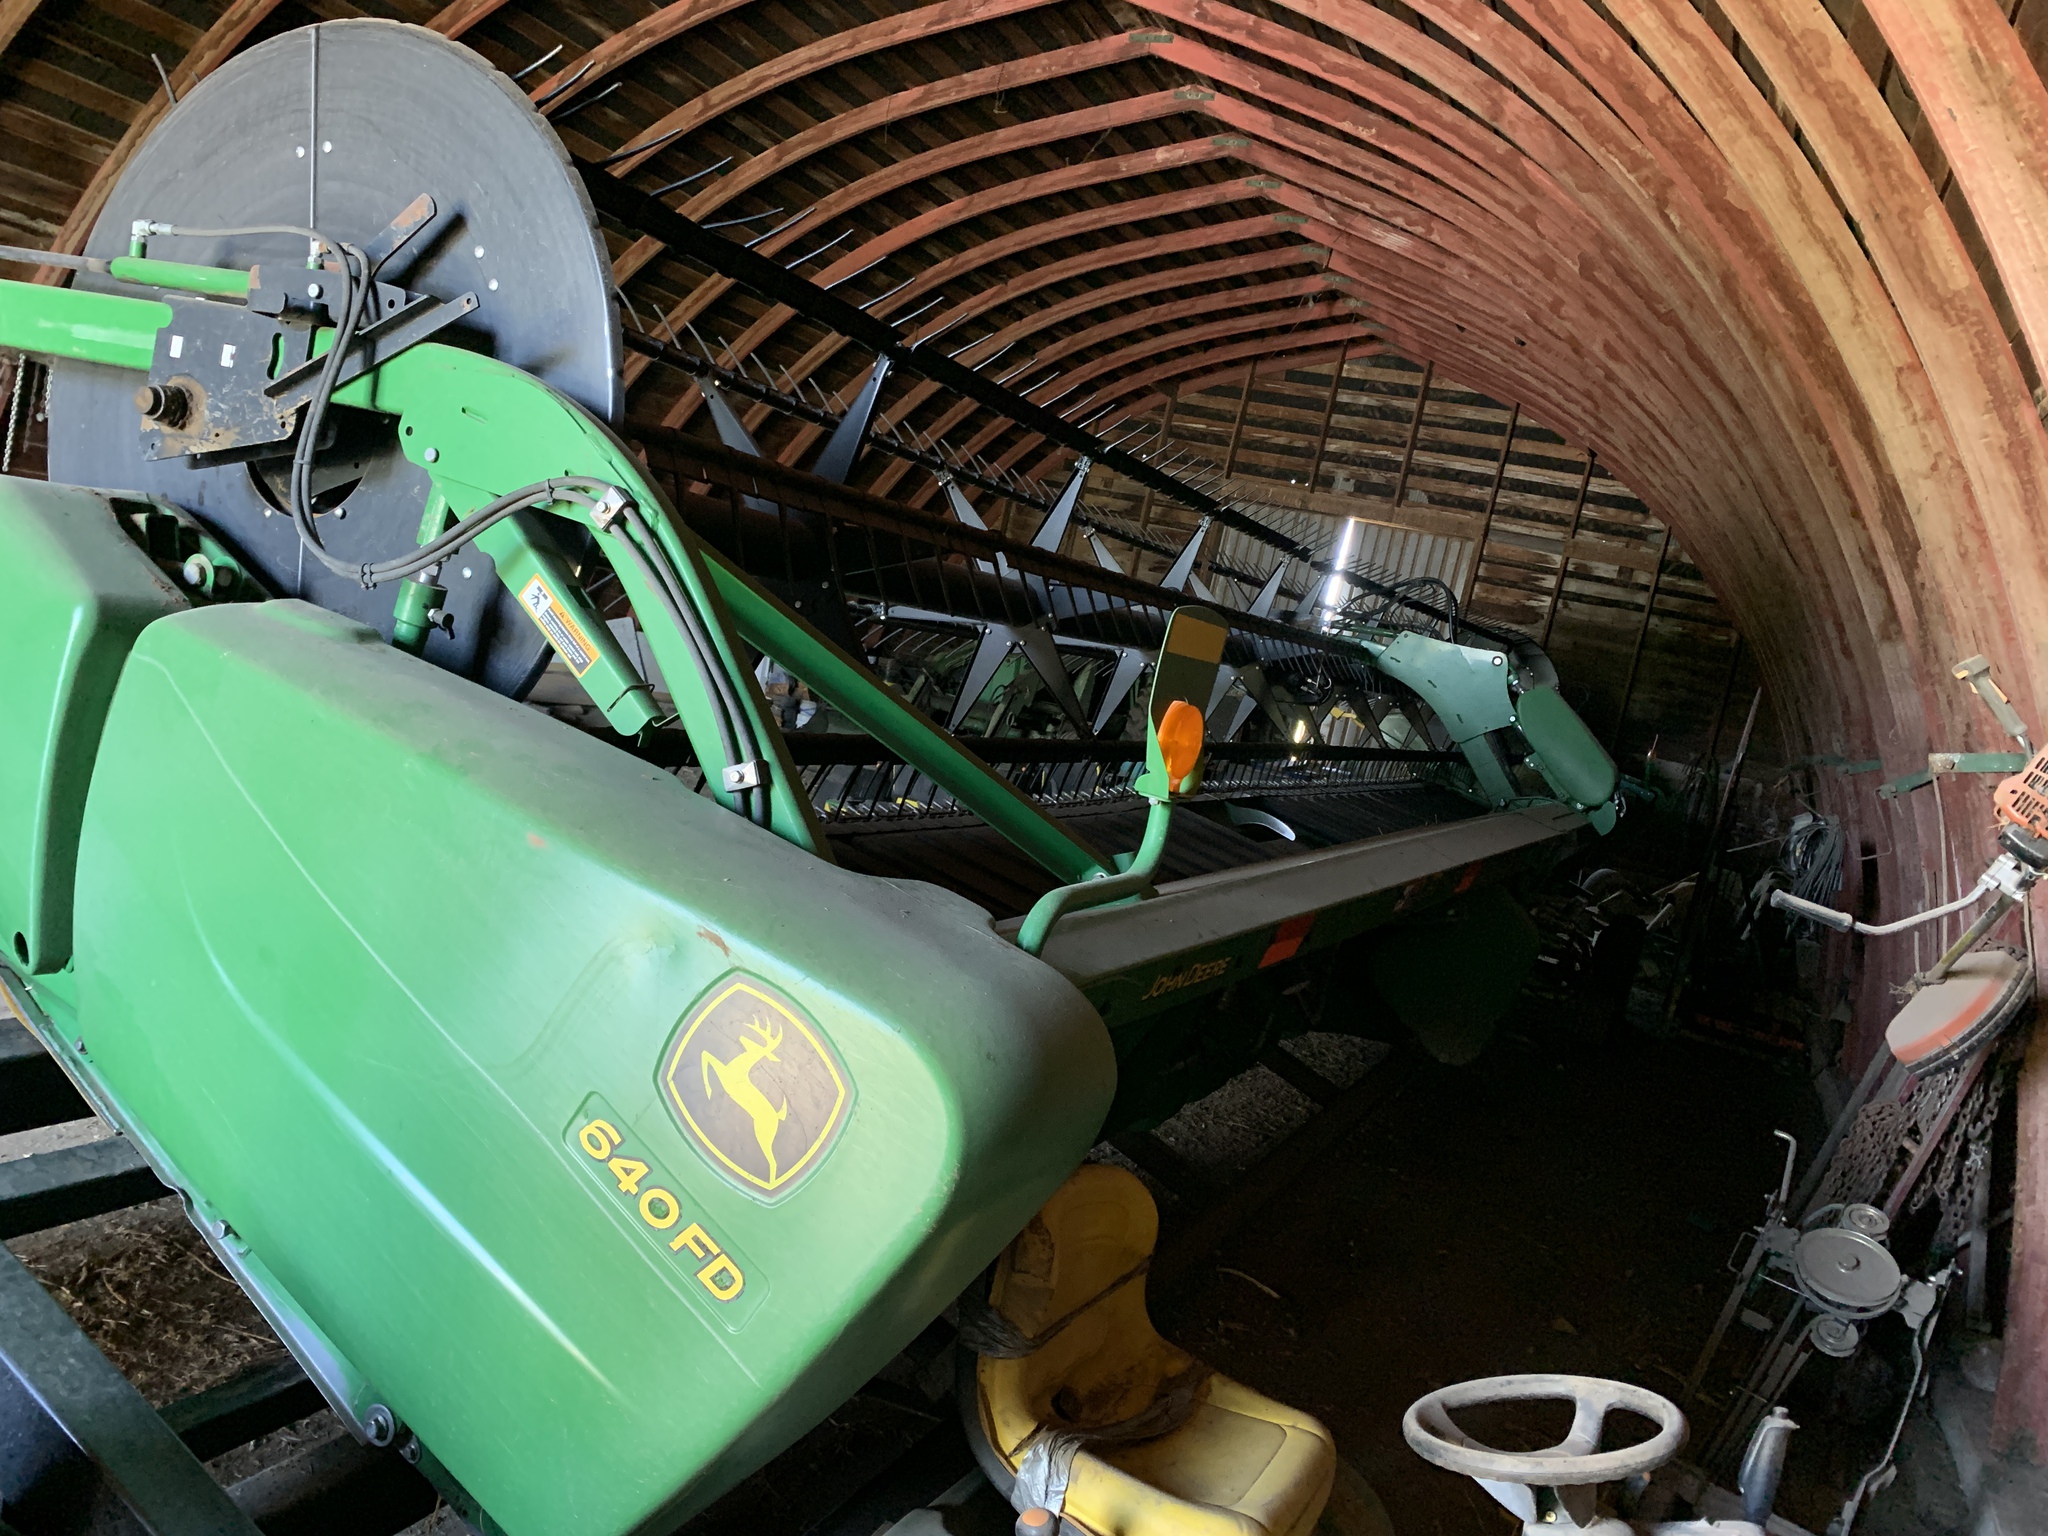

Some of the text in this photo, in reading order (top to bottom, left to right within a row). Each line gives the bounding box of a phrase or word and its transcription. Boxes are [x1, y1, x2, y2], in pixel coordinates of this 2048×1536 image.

[565, 618, 591, 651] WARNING
[1141, 956, 1233, 1001] JOHN DEERE
[578, 1118, 746, 1301] 640FD
